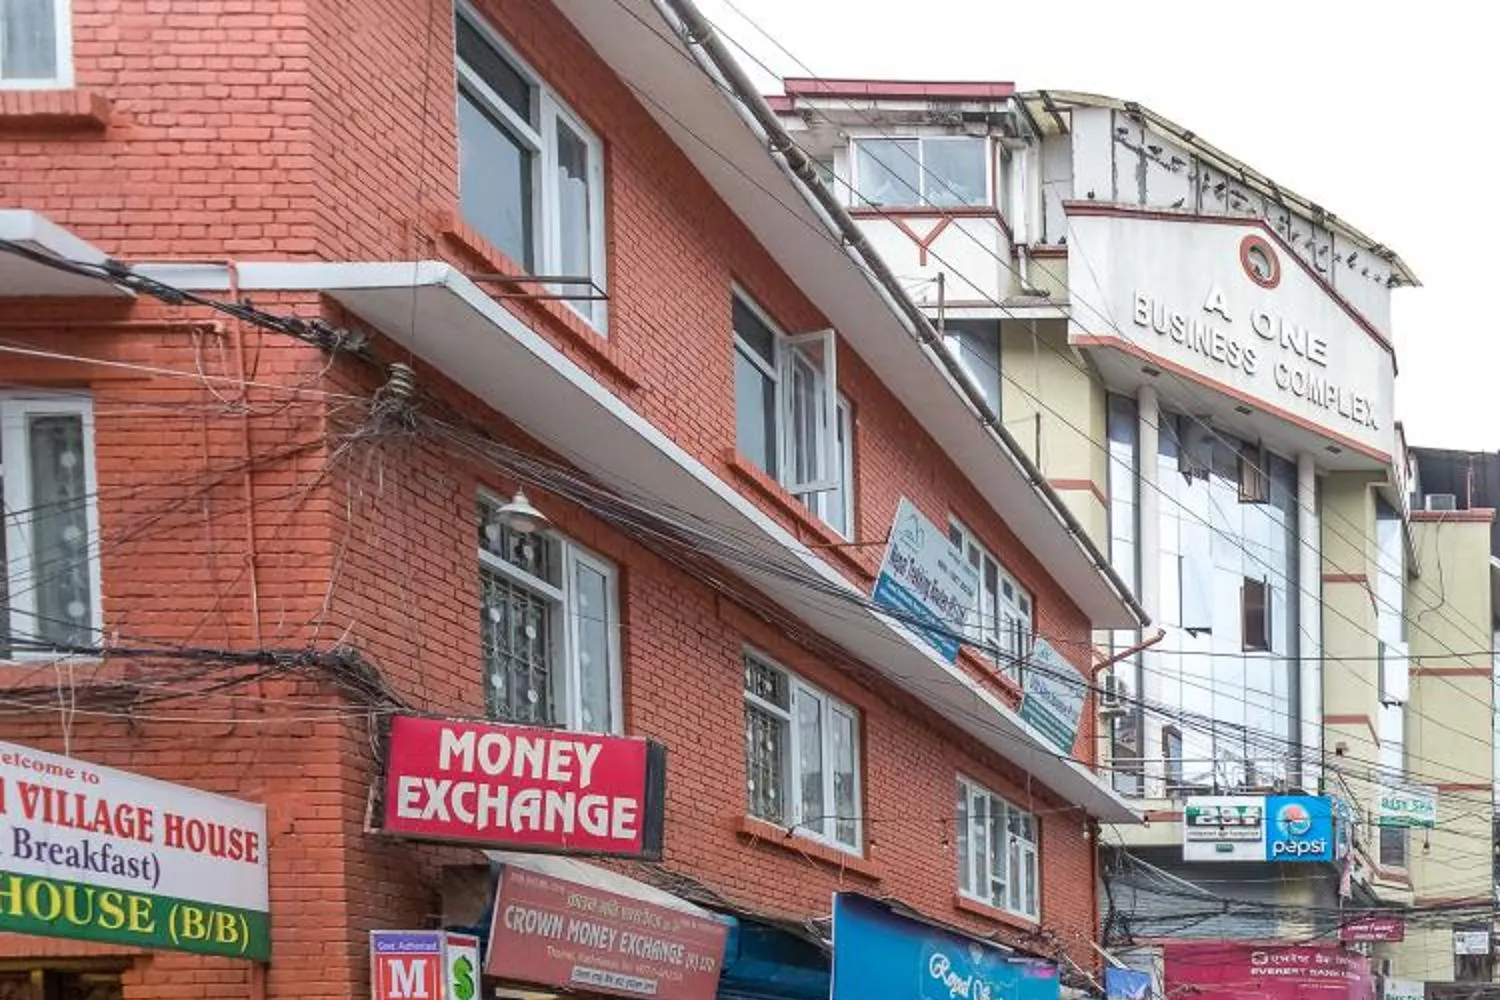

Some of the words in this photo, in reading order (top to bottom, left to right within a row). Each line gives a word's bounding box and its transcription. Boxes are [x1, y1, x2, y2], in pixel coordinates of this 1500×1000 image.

[1203, 283, 1232, 322] A
[1251, 308, 1328, 368] ONE
[1133, 288, 1257, 375] BUSINESS
[1274, 362, 1380, 431] COMPLEX
[0, 752, 77, 780] elcome
[81, 770, 100, 785] to
[438, 727, 603, 789] MONEY
[17, 780, 153, 843] VILLAGE
[164, 812, 259, 864] HOUSE
[397, 775, 638, 840] EXCHANGE
[12, 825, 161, 889] Breakfast)
[1272, 836, 1327, 857] pepsi
[0, 873, 155, 933] HOUSE
[169, 903, 249, 952] (B/B)
[503, 905, 563, 941] CROWN
[566, 919, 615, 952] MONEY
[619, 932, 684, 965] EXCHANGE
[1250, 968, 1307, 976] EVEREST
